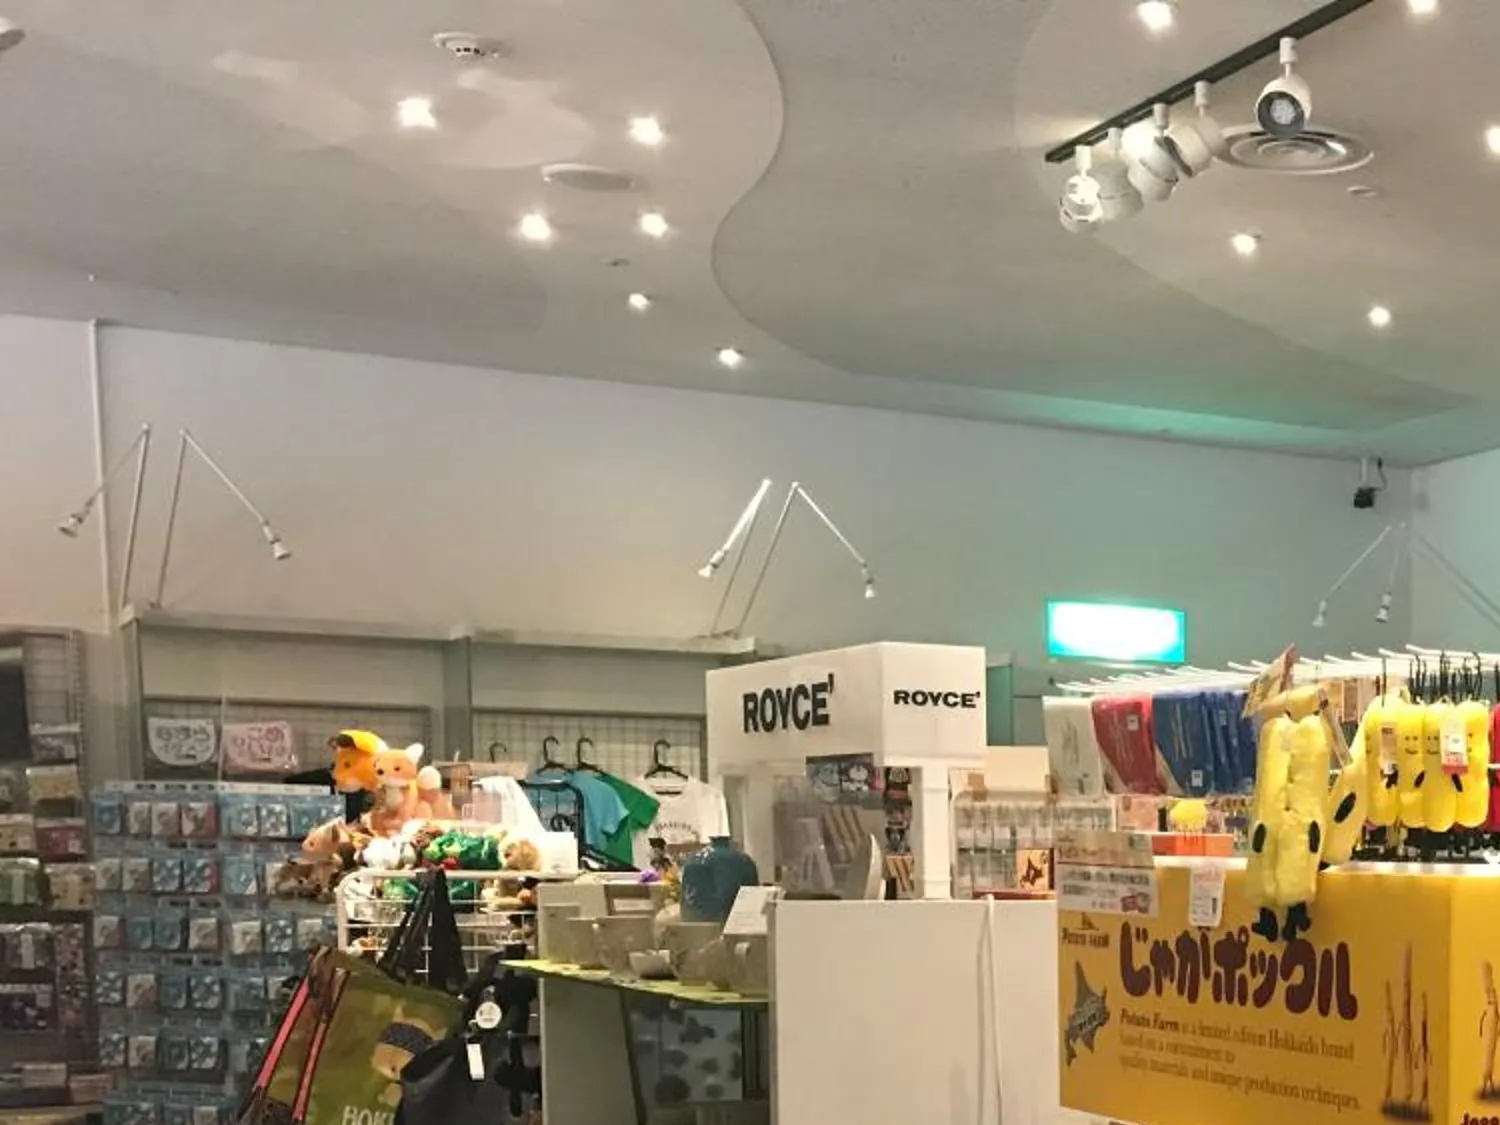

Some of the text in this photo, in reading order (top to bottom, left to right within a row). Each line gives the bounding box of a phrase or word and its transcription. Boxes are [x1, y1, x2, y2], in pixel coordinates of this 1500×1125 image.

[742, 672, 834, 734] ROYCE'
[893, 689, 981, 709] ROYCE'
[1119, 921, 1358, 1020] じゃがポックル
[1153, 1012, 1179, 1031] Farm
